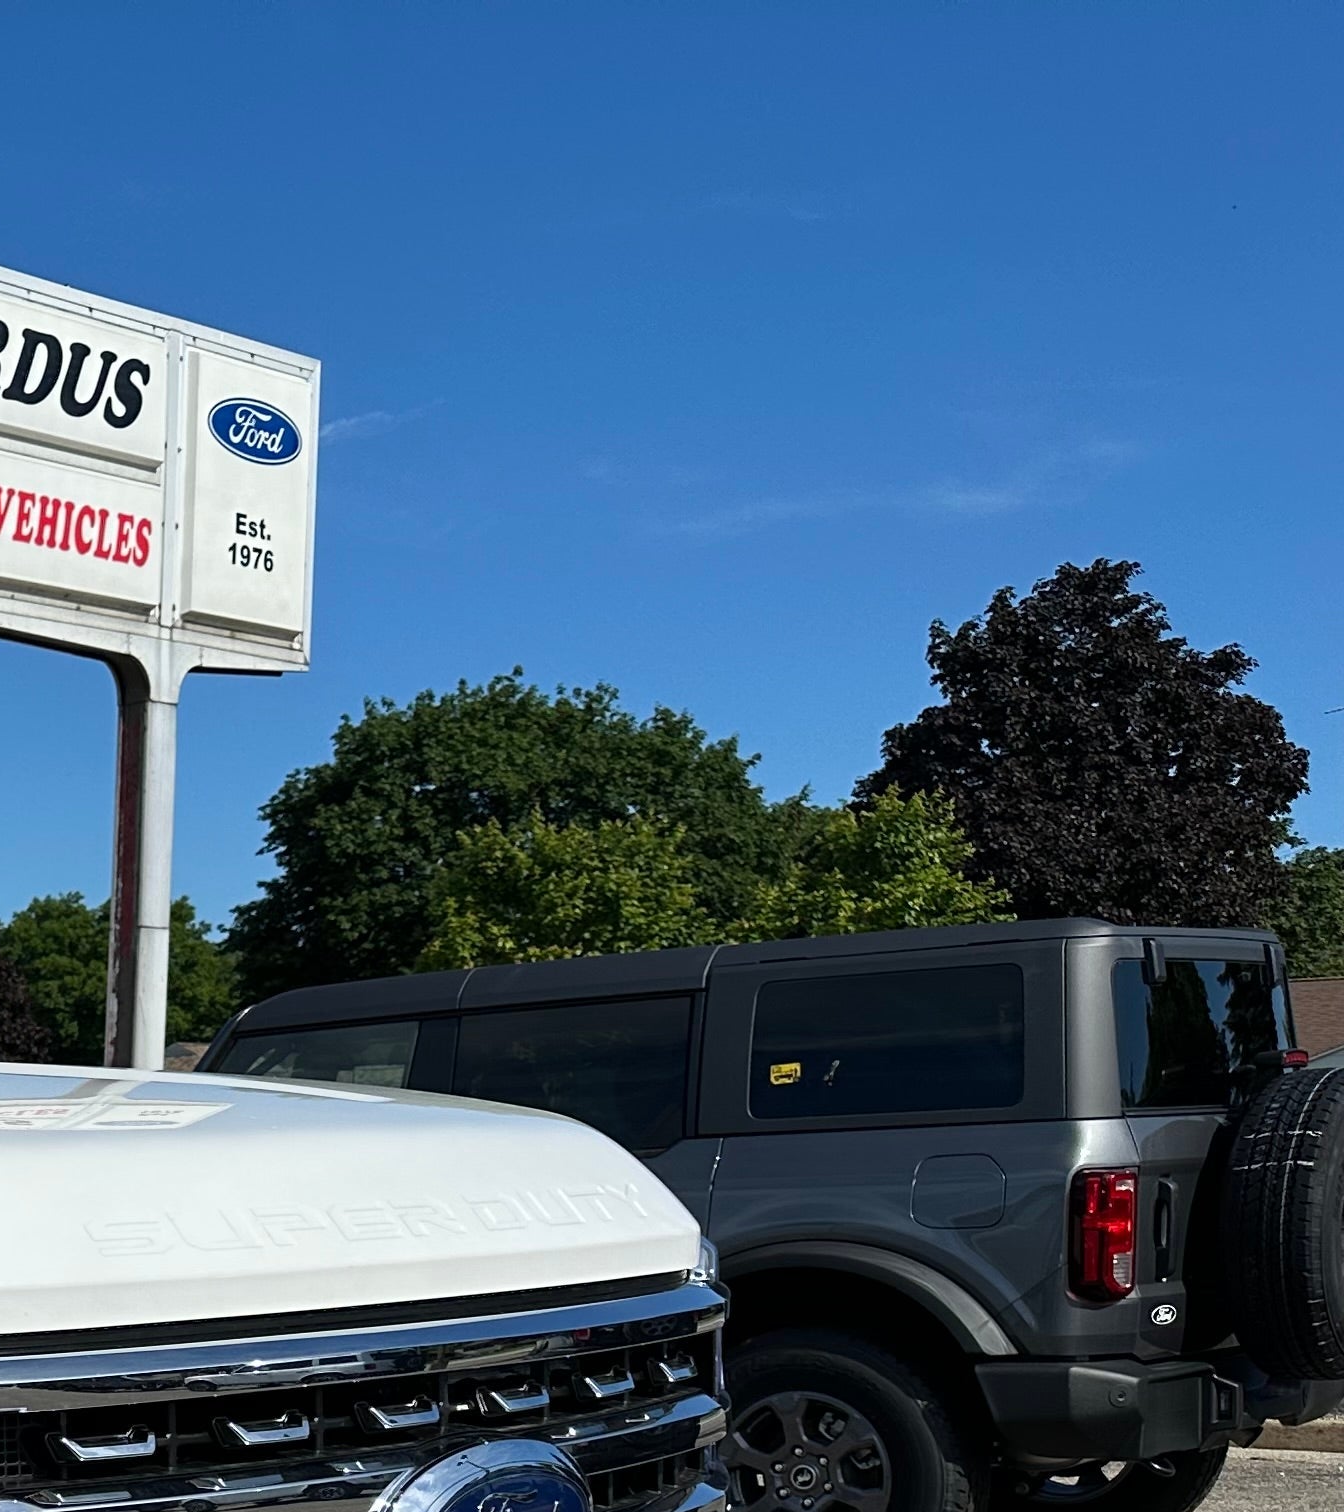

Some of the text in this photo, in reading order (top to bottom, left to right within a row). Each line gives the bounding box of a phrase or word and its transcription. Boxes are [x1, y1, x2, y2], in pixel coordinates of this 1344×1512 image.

[235, 511, 272, 541] Est.
[228, 541, 275, 573] 1976
[81, 1181, 650, 1259] SUPER DUTY
